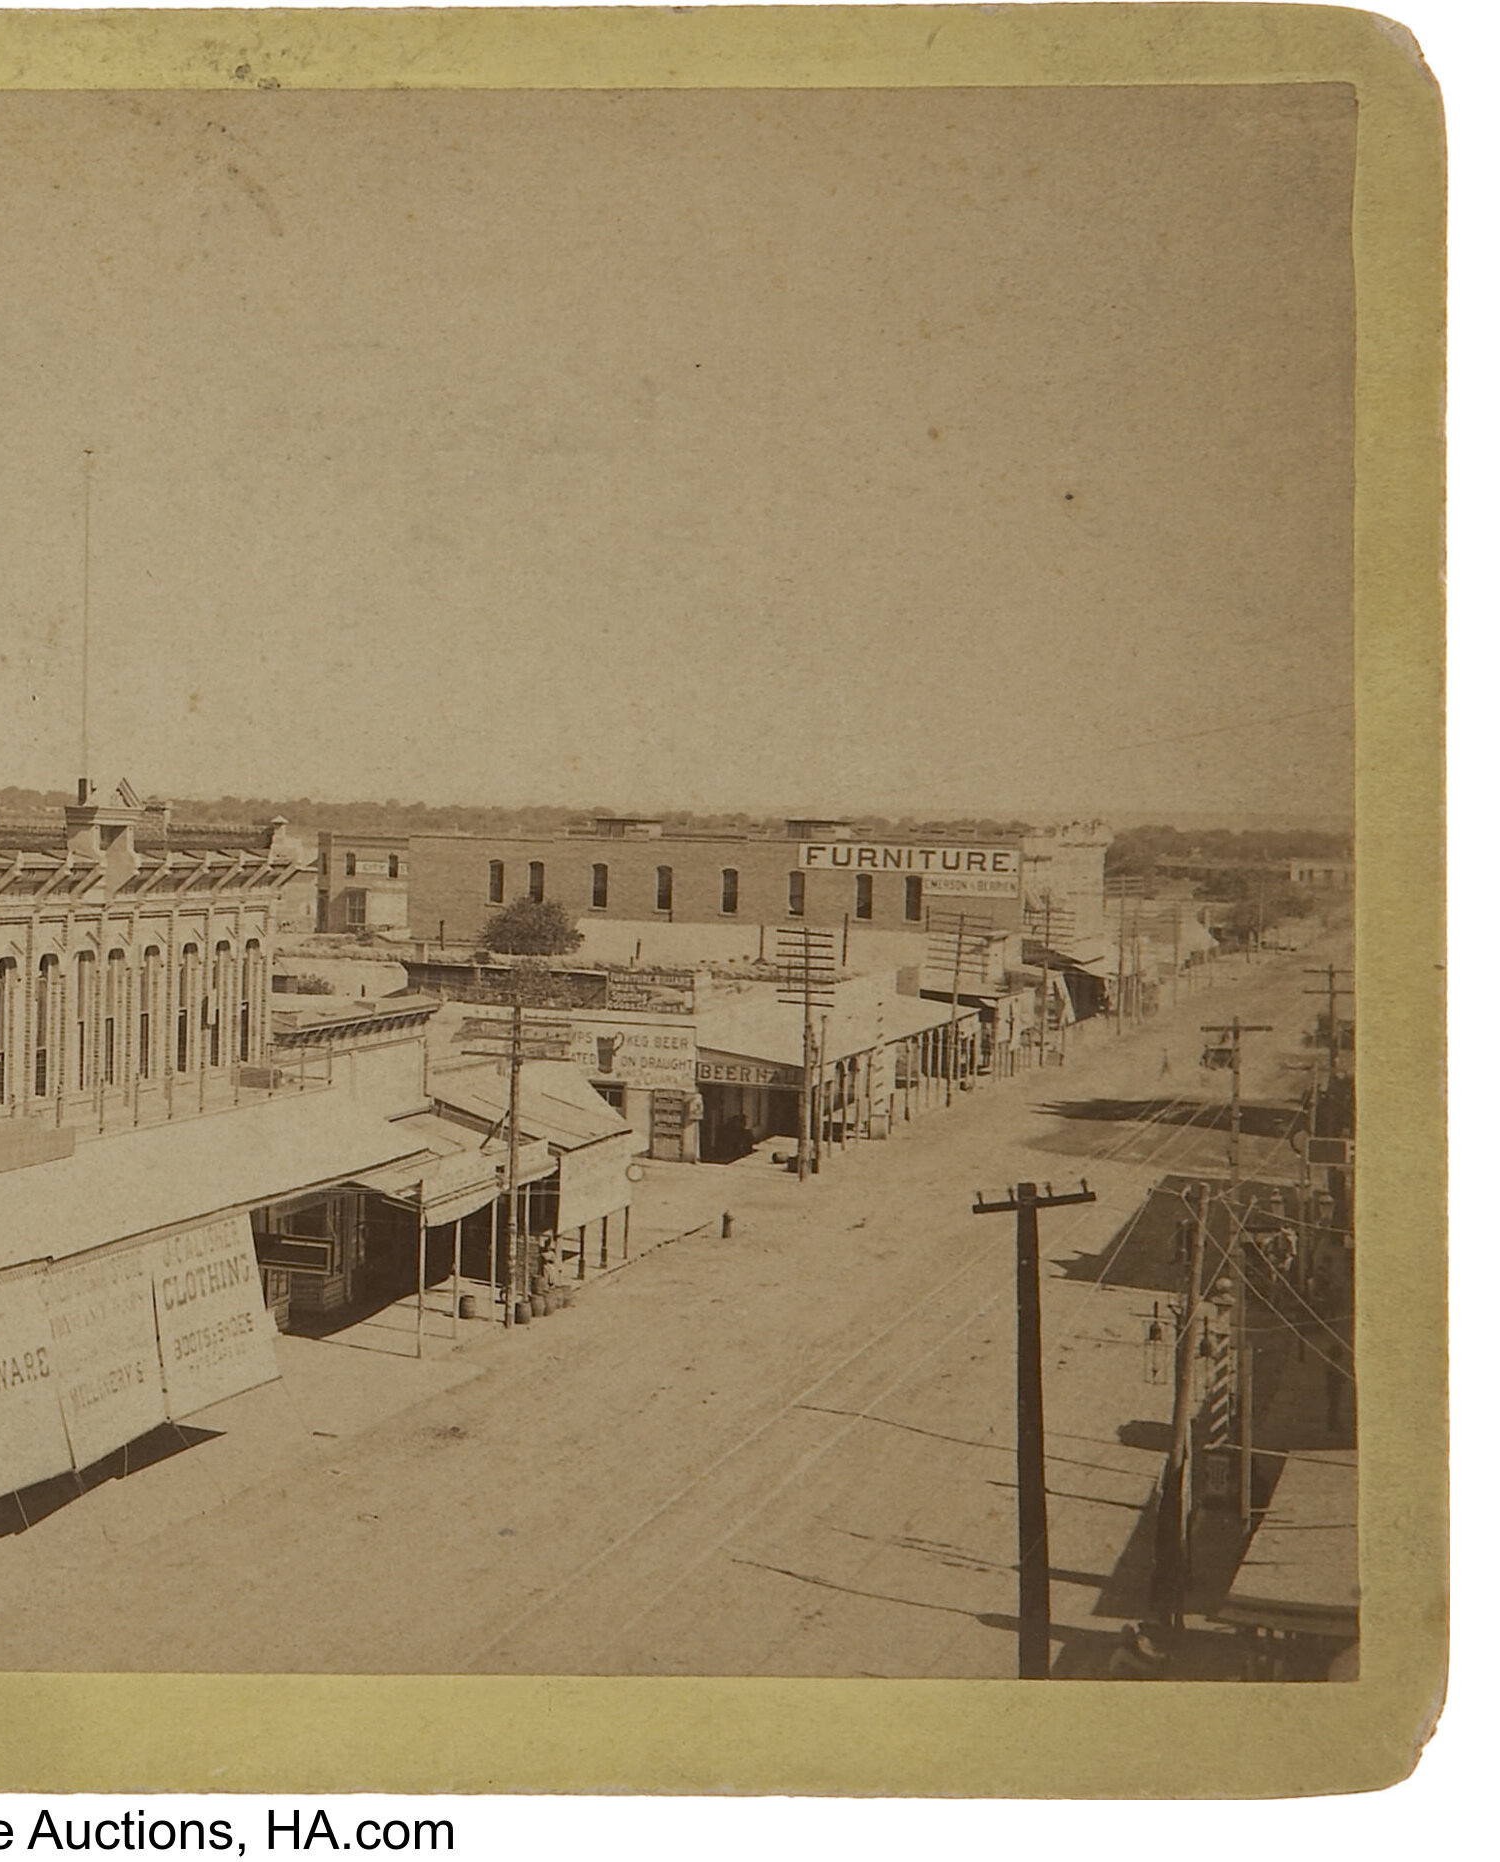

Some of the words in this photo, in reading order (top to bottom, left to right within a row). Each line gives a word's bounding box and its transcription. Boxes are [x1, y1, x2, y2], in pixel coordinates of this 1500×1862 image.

[805, 846, 1018, 873] FURNITURE.
[654, 1036, 689, 1050] BEER
[621, 1055, 636, 1068] ON
[641, 1056, 694, 1071] DRAUGHT
[700, 1063, 751, 1082] BEER
